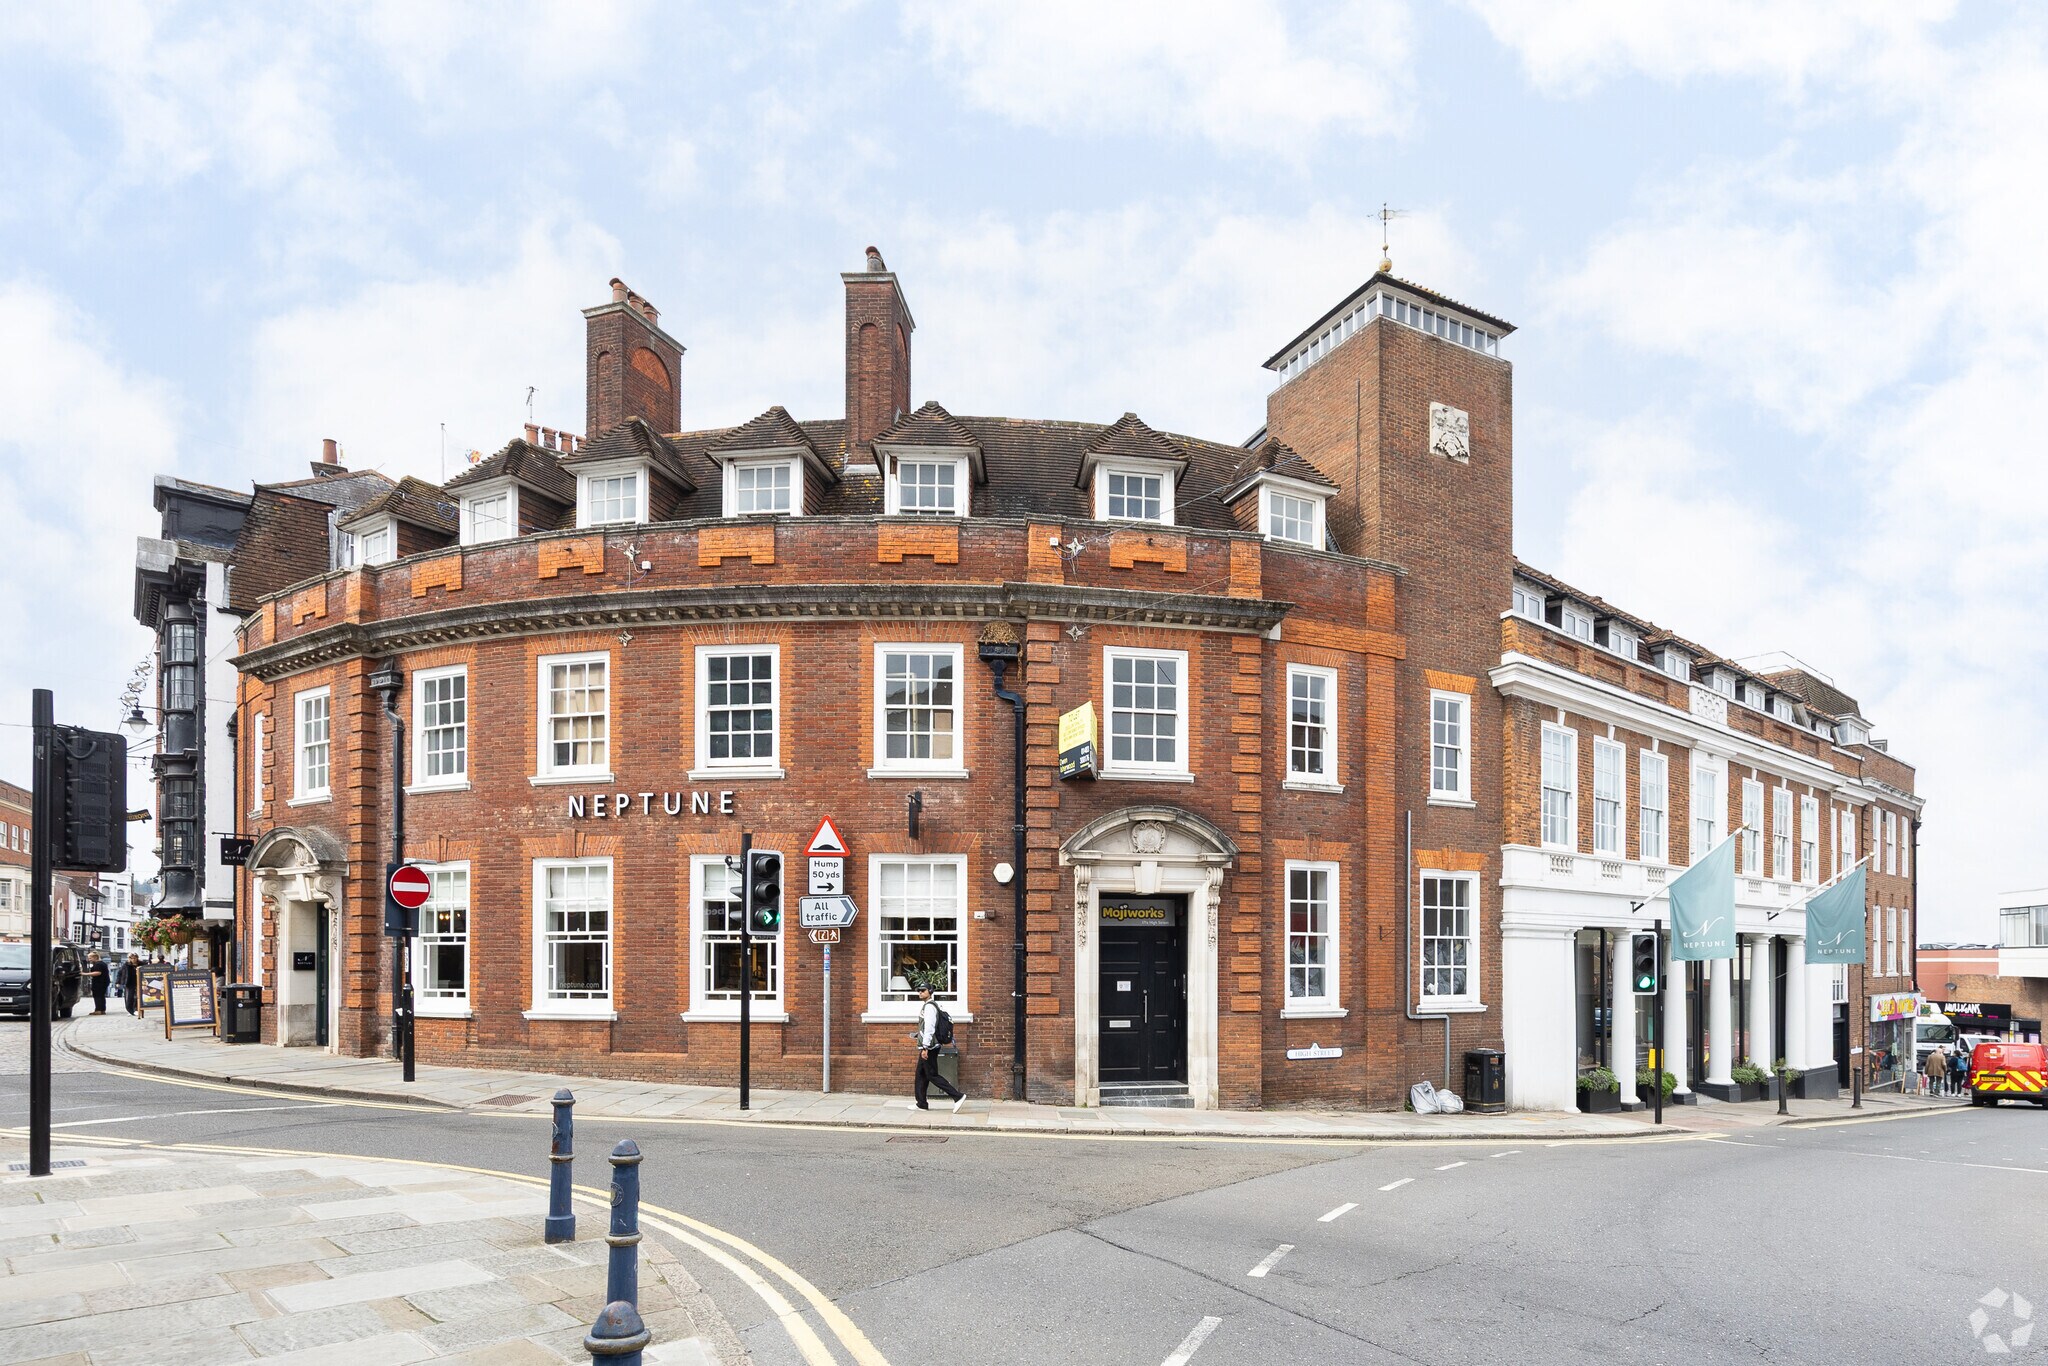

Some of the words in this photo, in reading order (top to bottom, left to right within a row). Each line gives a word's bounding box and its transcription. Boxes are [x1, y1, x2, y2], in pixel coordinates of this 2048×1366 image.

[568, 790, 734, 818] NEPTUNE
[814, 860, 839, 868] Hump
[826, 871, 840, 879] yds
[814, 902, 829, 911] All
[1102, 904, 1165, 920] Mojiworks
[806, 913, 837, 922] traffic
[1683, 940, 1726, 948] NEPTUNE
[1944, 1003, 1981, 1014] MULLIGANS
